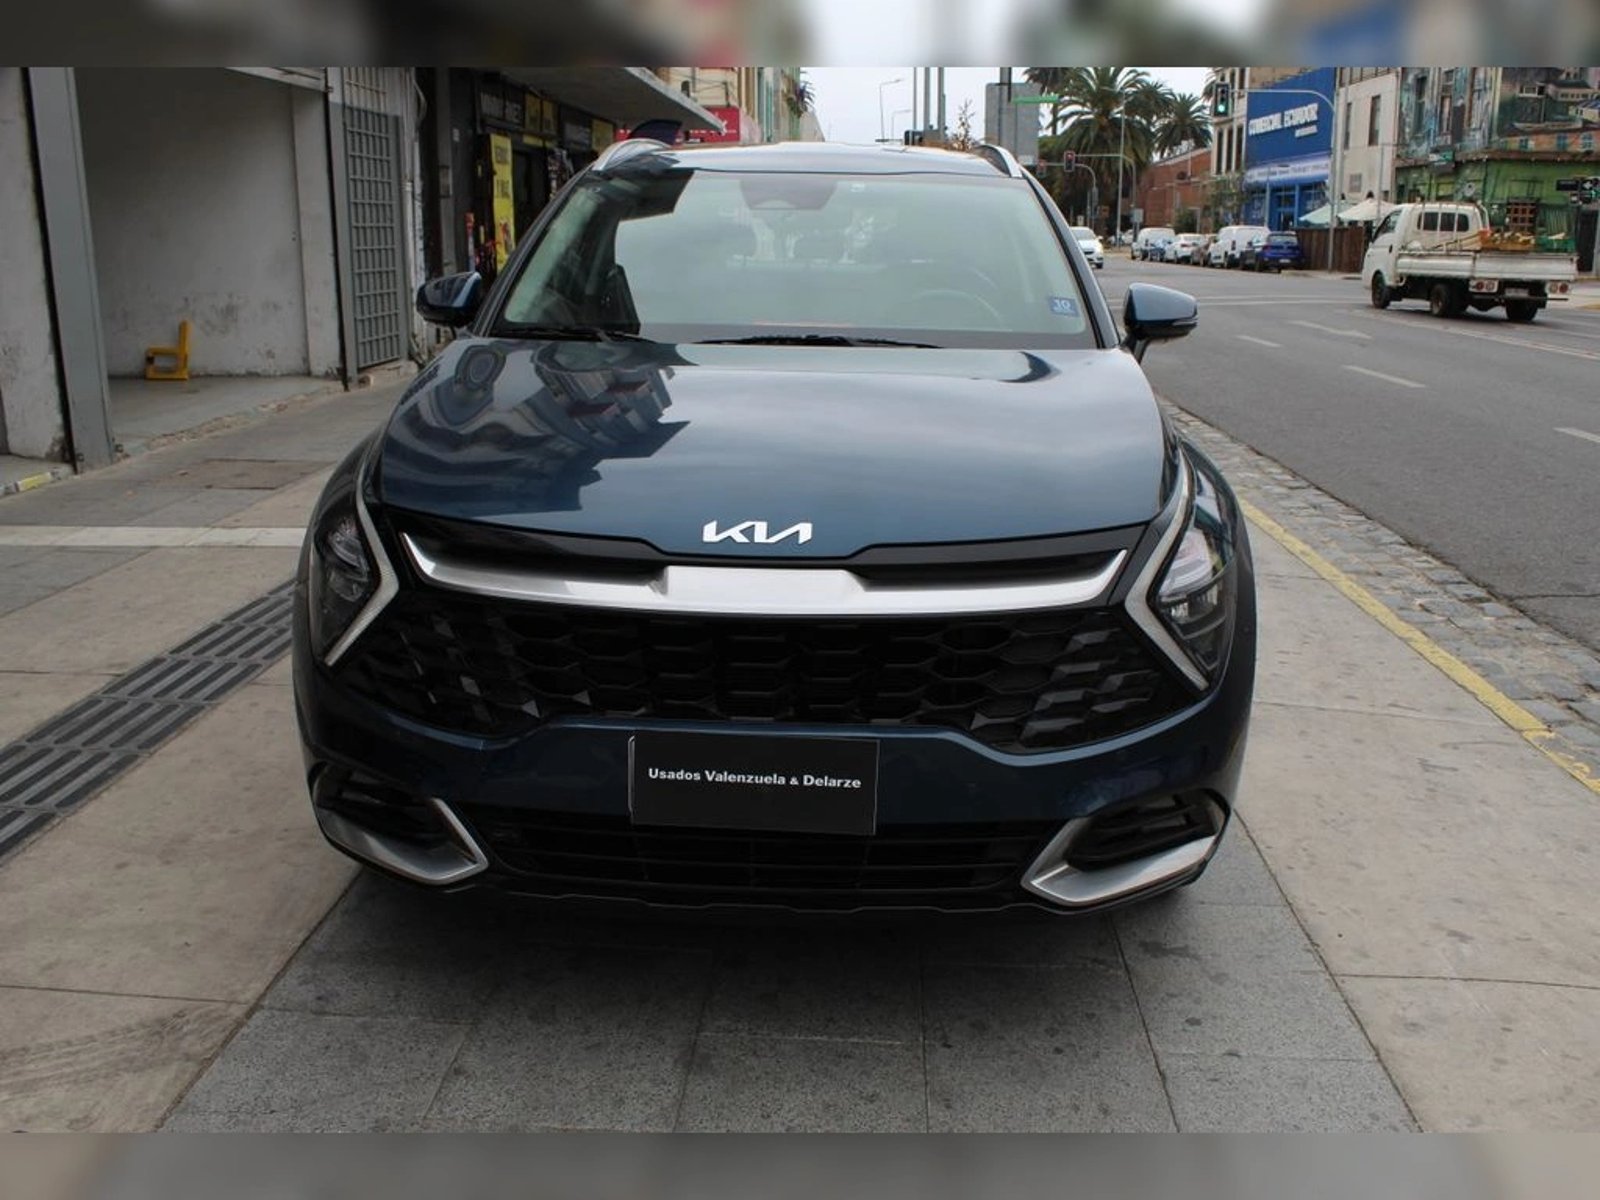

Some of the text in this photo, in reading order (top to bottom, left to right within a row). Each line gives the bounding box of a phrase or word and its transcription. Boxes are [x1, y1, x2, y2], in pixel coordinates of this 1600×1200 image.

[648, 768, 861, 788] Usados Valenzuela & Delarze
